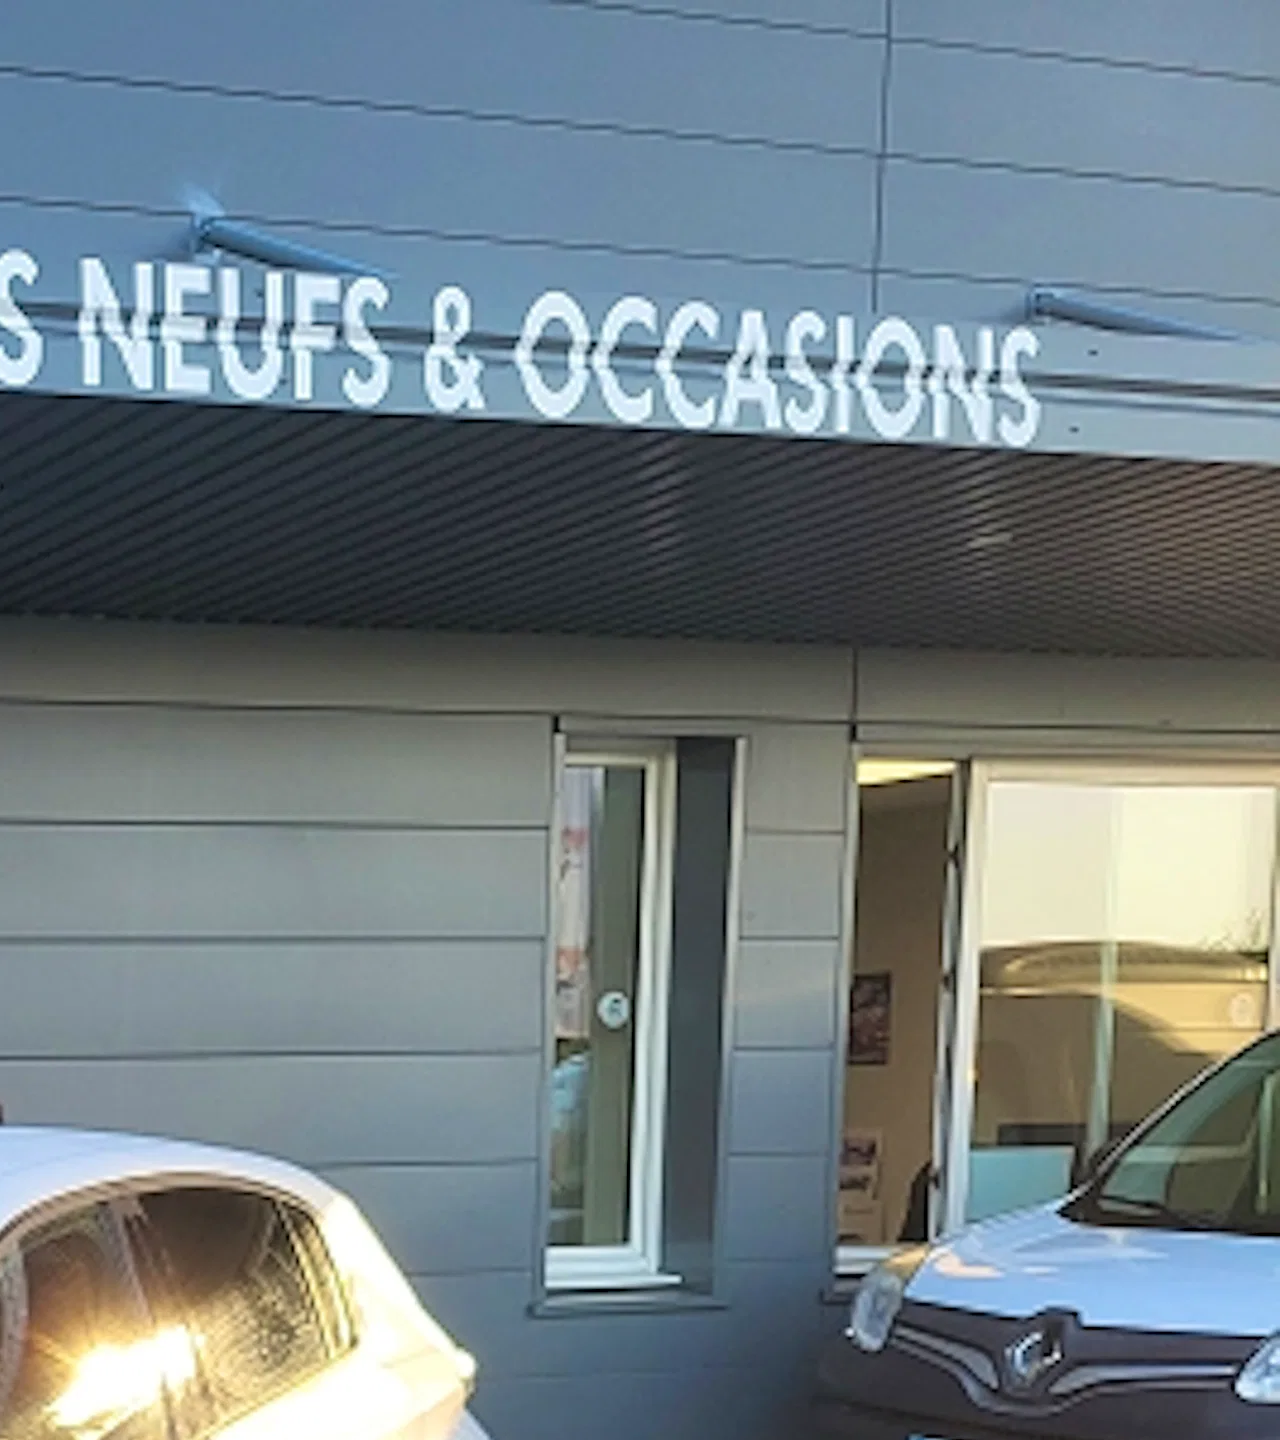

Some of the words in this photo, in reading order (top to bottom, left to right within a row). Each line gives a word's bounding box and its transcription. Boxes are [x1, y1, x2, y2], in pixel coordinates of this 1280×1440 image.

[78, 256, 392, 408] NEUFS
[424, 285, 484, 413] &
[516, 289, 1040, 448] OCCASIONS
